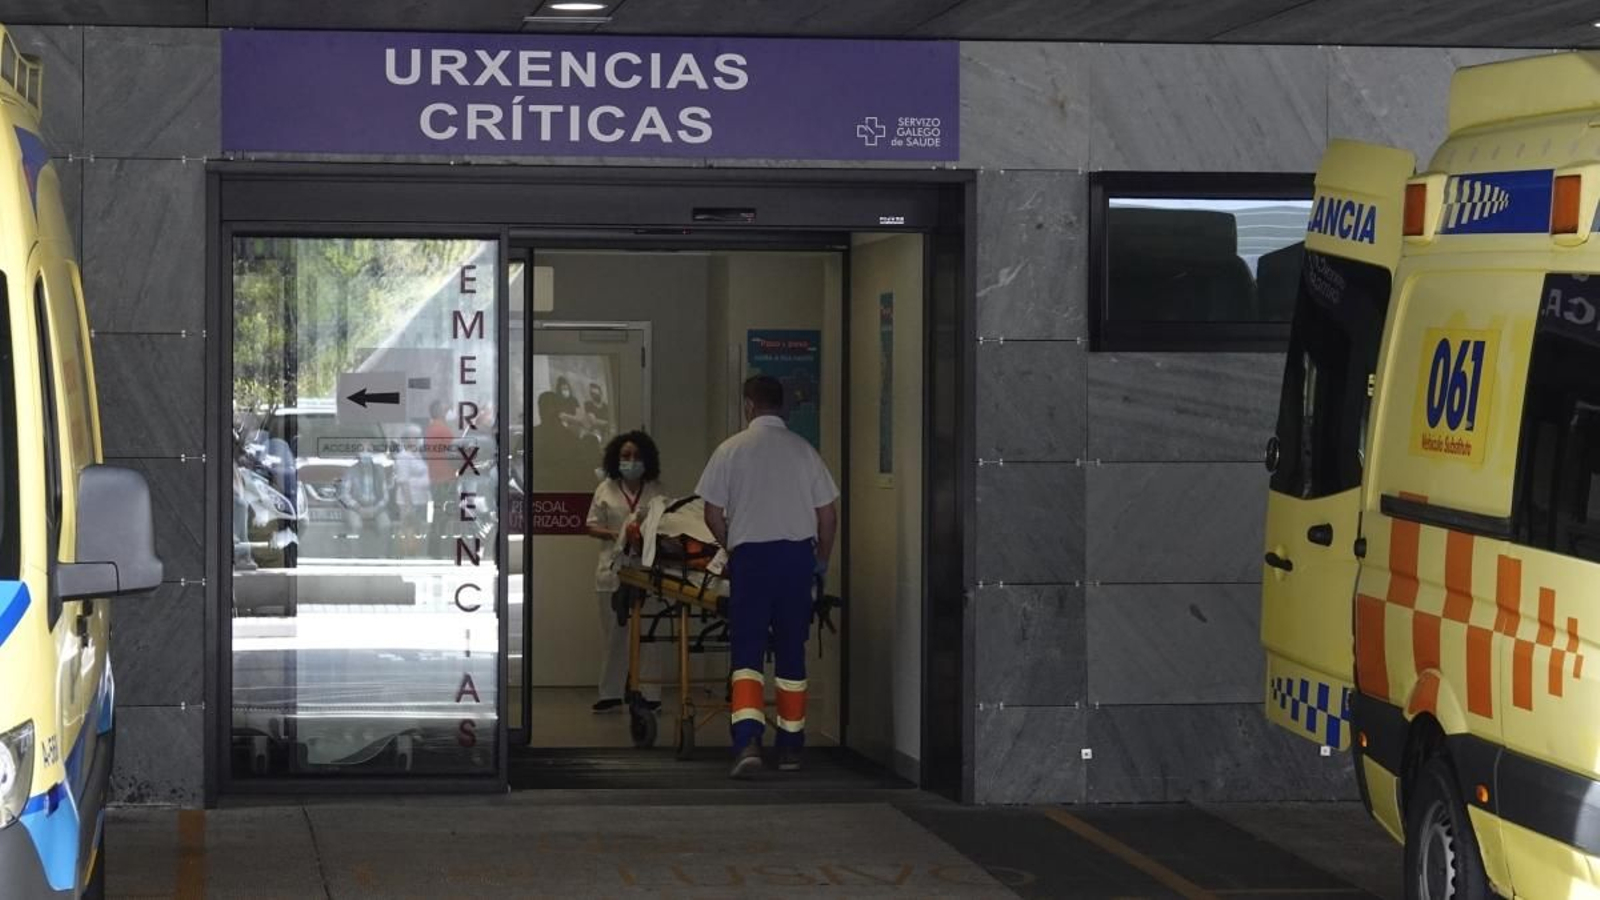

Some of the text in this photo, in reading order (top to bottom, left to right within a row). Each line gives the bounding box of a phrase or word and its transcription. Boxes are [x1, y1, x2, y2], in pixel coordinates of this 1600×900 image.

[384, 48, 750, 91] URXENCIAS
[419, 95, 714, 145] CRÍTICAS
[891, 138, 904, 147] de
[896, 127, 941, 137] GALEGO
[897, 117, 941, 128] SERVIZO
[1308, 196, 1376, 244] ANCIA
[1427, 338, 1486, 431] 061
[452, 264, 485, 748] EMERXENCIAS
